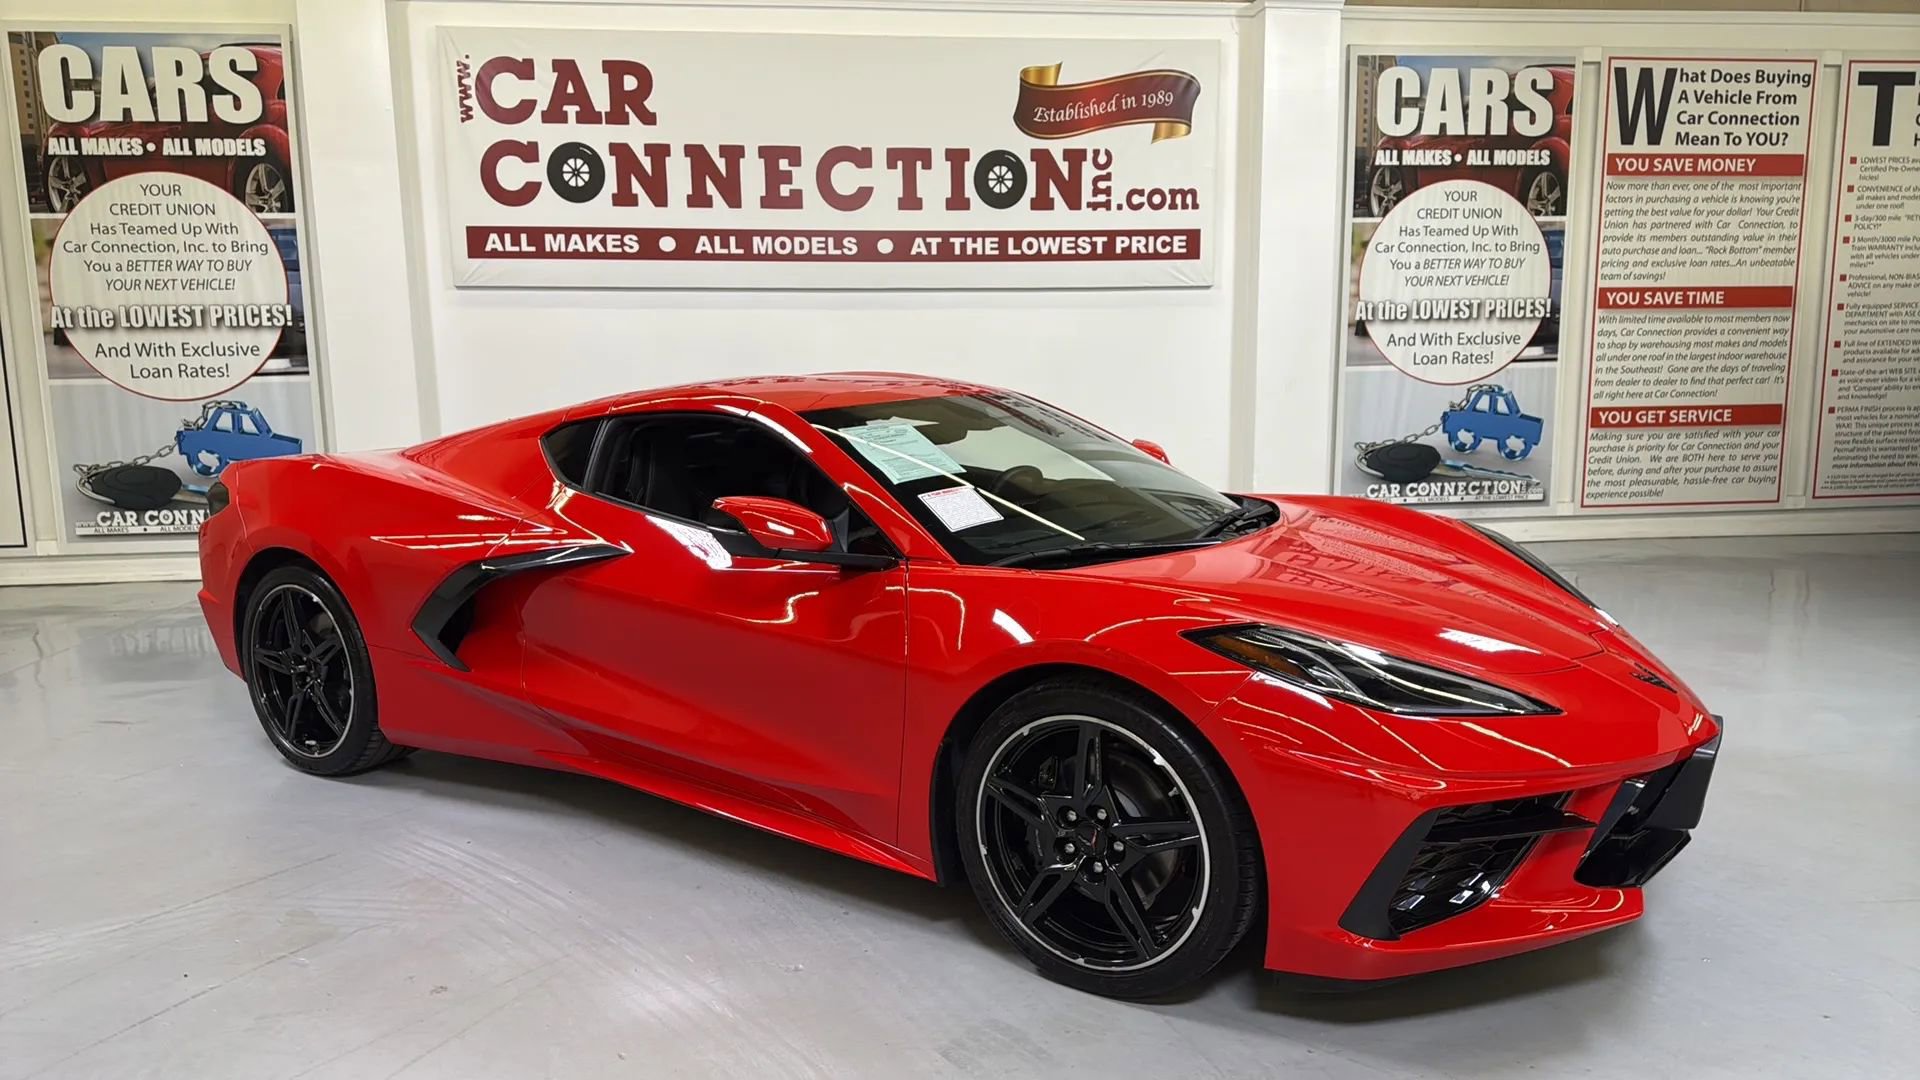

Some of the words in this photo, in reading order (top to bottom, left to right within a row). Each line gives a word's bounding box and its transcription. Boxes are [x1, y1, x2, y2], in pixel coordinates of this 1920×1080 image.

[38, 44, 263, 124] CARS
[1710, 69, 1751, 84] Does
[1755, 70, 1812, 88] Buying
[475, 56, 657, 126] CAR
[1678, 90, 1689, 104] A
[1694, 90, 1752, 105] Vehicle
[1756, 91, 1797, 105] From
[1033, 92, 1117, 123] Established
[1121, 93, 1137, 109] in
[1141, 90, 1174, 108] 1989
[1376, 66, 1554, 137] CARS
[1677, 111, 1704, 125] Car
[1708, 111, 1800, 126] Connection
[1675, 132, 1719, 146] Mean
[1724, 132, 1742, 146] To
[1746, 132, 1788, 146] YOU?
[48, 137, 78, 156] ALL
[81, 138, 144, 156] MAKES
[162, 138, 192, 156] ALL
[195, 138, 266, 157] MODELS
[1375, 150, 1399, 166] ALL
[1402, 150, 1452, 166] MAKES
[1466, 149, 1492, 166] ALL
[1494, 150, 1550, 166] MODELS
[1616, 160, 1649, 171] YOU
[1653, 159, 1693, 171] SAVE
[1697, 159, 1756, 172] MONEY
[480, 139, 1087, 211] CONNECTION
[140, 184, 182, 196] YOUR
[1606, 182, 1625, 190] Now
[1651, 182, 1670, 190] than
[1710, 181, 1720, 190] of
[1721, 182, 1734, 190] the
[1761, 183, 1801, 192] important
[1116, 188, 1199, 211] .com
[1445, 191, 1478, 202] YOUR
[1606, 195, 1633, 203] factors
[1635, 195, 1643, 203] in
[1645, 195, 1691, 204] purchasing
[1701, 195, 1729, 203] vehicle
[1732, 195, 1737, 203] is
[1740, 195, 1774, 205] knowing
[1776, 195, 1800, 204] you're
[110, 203, 161, 216] CREDIT
[166, 203, 215, 216] UNION
[1417, 208, 1459, 219] CREDIT
[1462, 208, 1503, 219] UNION
[90, 222, 116, 235] Has
[119, 222, 176, 235] Teamed
[182, 222, 202, 237] Up
[205, 222, 238, 235] With
[1399, 226, 1421, 237] Has
[1423, 225, 1468, 237] Teamed
[1472, 225, 1489, 238] Up
[1491, 225, 1518, 236] With
[63, 241, 87, 253] Car
[91, 240, 180, 256] Connection,
[184, 240, 208, 253] Inc.
[212, 242, 226, 253] to
[231, 241, 268, 256] Bring
[485, 233, 535, 253] ALL
[545, 234, 639, 253] MAKES
[695, 236, 744, 254] ALL
[752, 236, 858, 256] MODELS
[910, 237, 941, 255] AT
[950, 237, 999, 255] THE
[1008, 236, 1107, 255] LOWEST
[1115, 236, 1187, 254] PRICE
[1375, 243, 1394, 253] Car
[1398, 243, 1468, 255] Connection,
[1472, 242, 1492, 252] Inc.
[1495, 243, 1506, 252] to
[1510, 242, 1540, 254] Bring
[84, 260, 113, 272] You
[116, 262, 122, 272] a
[126, 260, 174, 272] BETTER
[176, 260, 204, 272] WAY
[208, 260, 224, 272] TO
[227, 260, 251, 271] BUY
[1390, 259, 1413, 270] You
[1415, 262, 1421, 270] a
[1423, 259, 1461, 270] BETTER
[1464, 259, 1487, 269] WAY
[1489, 259, 1502, 269] TO
[1504, 258, 1525, 269] BUY
[105, 278, 145, 291] YOUR
[146, 278, 180, 291] NEXT
[181, 278, 236, 290] VEHICLE!
[1405, 276, 1434, 287] YOUR
[1436, 275, 1464, 287] NEXT
[1466, 275, 1509, 286] VEHICLE!
[1607, 292, 1640, 305] YOU
[1644, 292, 1683, 305] SAVE
[1687, 291, 1724, 304] TIME
[52, 305, 73, 329] At
[78, 306, 114, 329] the
[119, 304, 204, 328] LOWEST
[210, 304, 292, 327] PRICES!
[1355, 300, 1374, 320] At
[1379, 301, 1407, 320] the
[1412, 300, 1480, 320] LOWEST
[1485, 298, 1551, 319] PRICES!
[1598, 315, 1617, 324] With
[1618, 315, 1647, 324] limited
[1648, 315, 1666, 323] time
[1667, 315, 1703, 323] available
[1735, 315, 1771, 323] members
[1387, 333, 1416, 347] And
[1420, 333, 1452, 346] With
[1458, 332, 1521, 345] Exclusive
[95, 343, 130, 358] And
[134, 342, 175, 357] With
[181, 342, 260, 357] Exclusive
[1413, 352, 1447, 365] Loan
[1452, 352, 1494, 364] Rates!
[130, 364, 172, 379] Loan
[179, 363, 230, 378] Rates!
[1599, 411, 1632, 424] YOU
[1635, 410, 1665, 423] GET
[1669, 409, 1732, 423] SERVICE
[1591, 432, 1622, 442] Making
[1647, 433, 1663, 441] you
[1685, 430, 1719, 439] satisfied
[1723, 430, 1740, 438] with
[1745, 431, 1763, 440] your
[1367, 484, 1400, 498] CAR
[1406, 481, 1522, 497] CONNECTION
[97, 511, 138, 526] CAR
